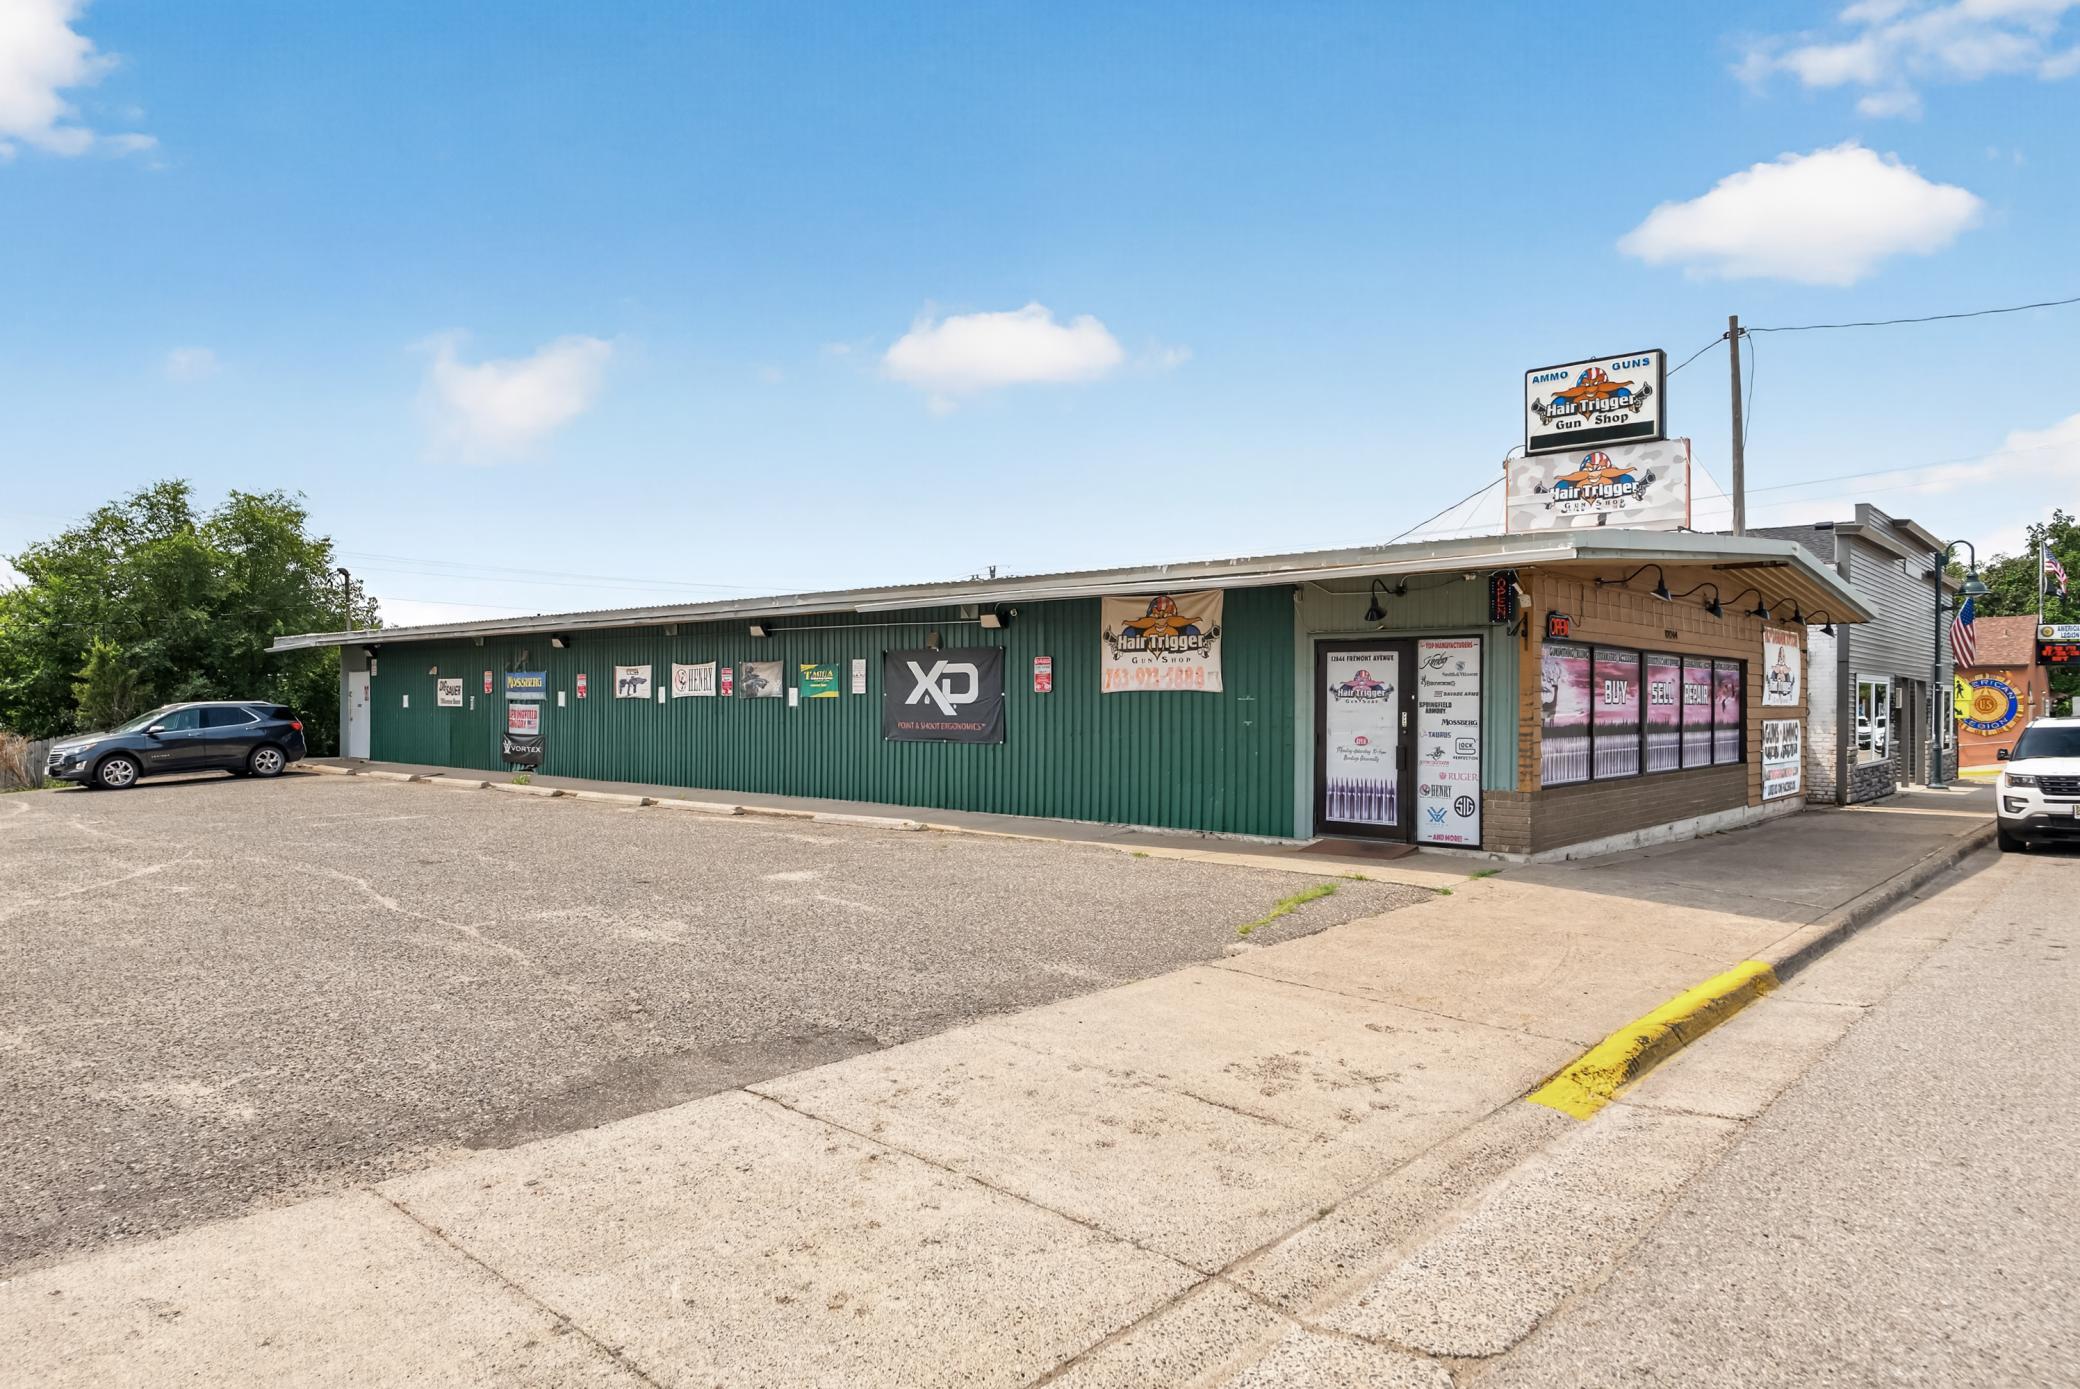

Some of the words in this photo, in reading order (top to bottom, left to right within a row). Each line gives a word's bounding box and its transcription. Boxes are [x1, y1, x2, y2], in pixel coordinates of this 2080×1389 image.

[1611, 357, 1650, 371] GUNS
[1532, 371, 1569, 384] AMMO
[1546, 402, 1578, 418] Hair
[1579, 395, 1636, 414] Trigger
[1556, 419, 1582, 430] Gun
[1594, 412, 1629, 425] Shop
[1550, 486, 1581, 501] Hair
[1582, 481, 1640, 498] Trigger
[1551, 617, 1569, 636] OPEN
[1118, 635, 1146, 650] Hair
[1149, 634, 1205, 651] Trigger
[688, 667, 713, 692] HENRY
[1604, 680, 1628, 704] BUY
[1651, 681, 1674, 705] SELL
[1684, 683, 1709, 705] REPAIR
[1441, 718, 1478, 726] MOSSBERG
[1428, 731, 1452, 739] TAURUS
[511, 745, 542, 753] VORTEX
[1448, 772, 1479, 781] RUGER
[1431, 784, 1452, 798] HENRY
[1455, 796, 1475, 817] SIG
